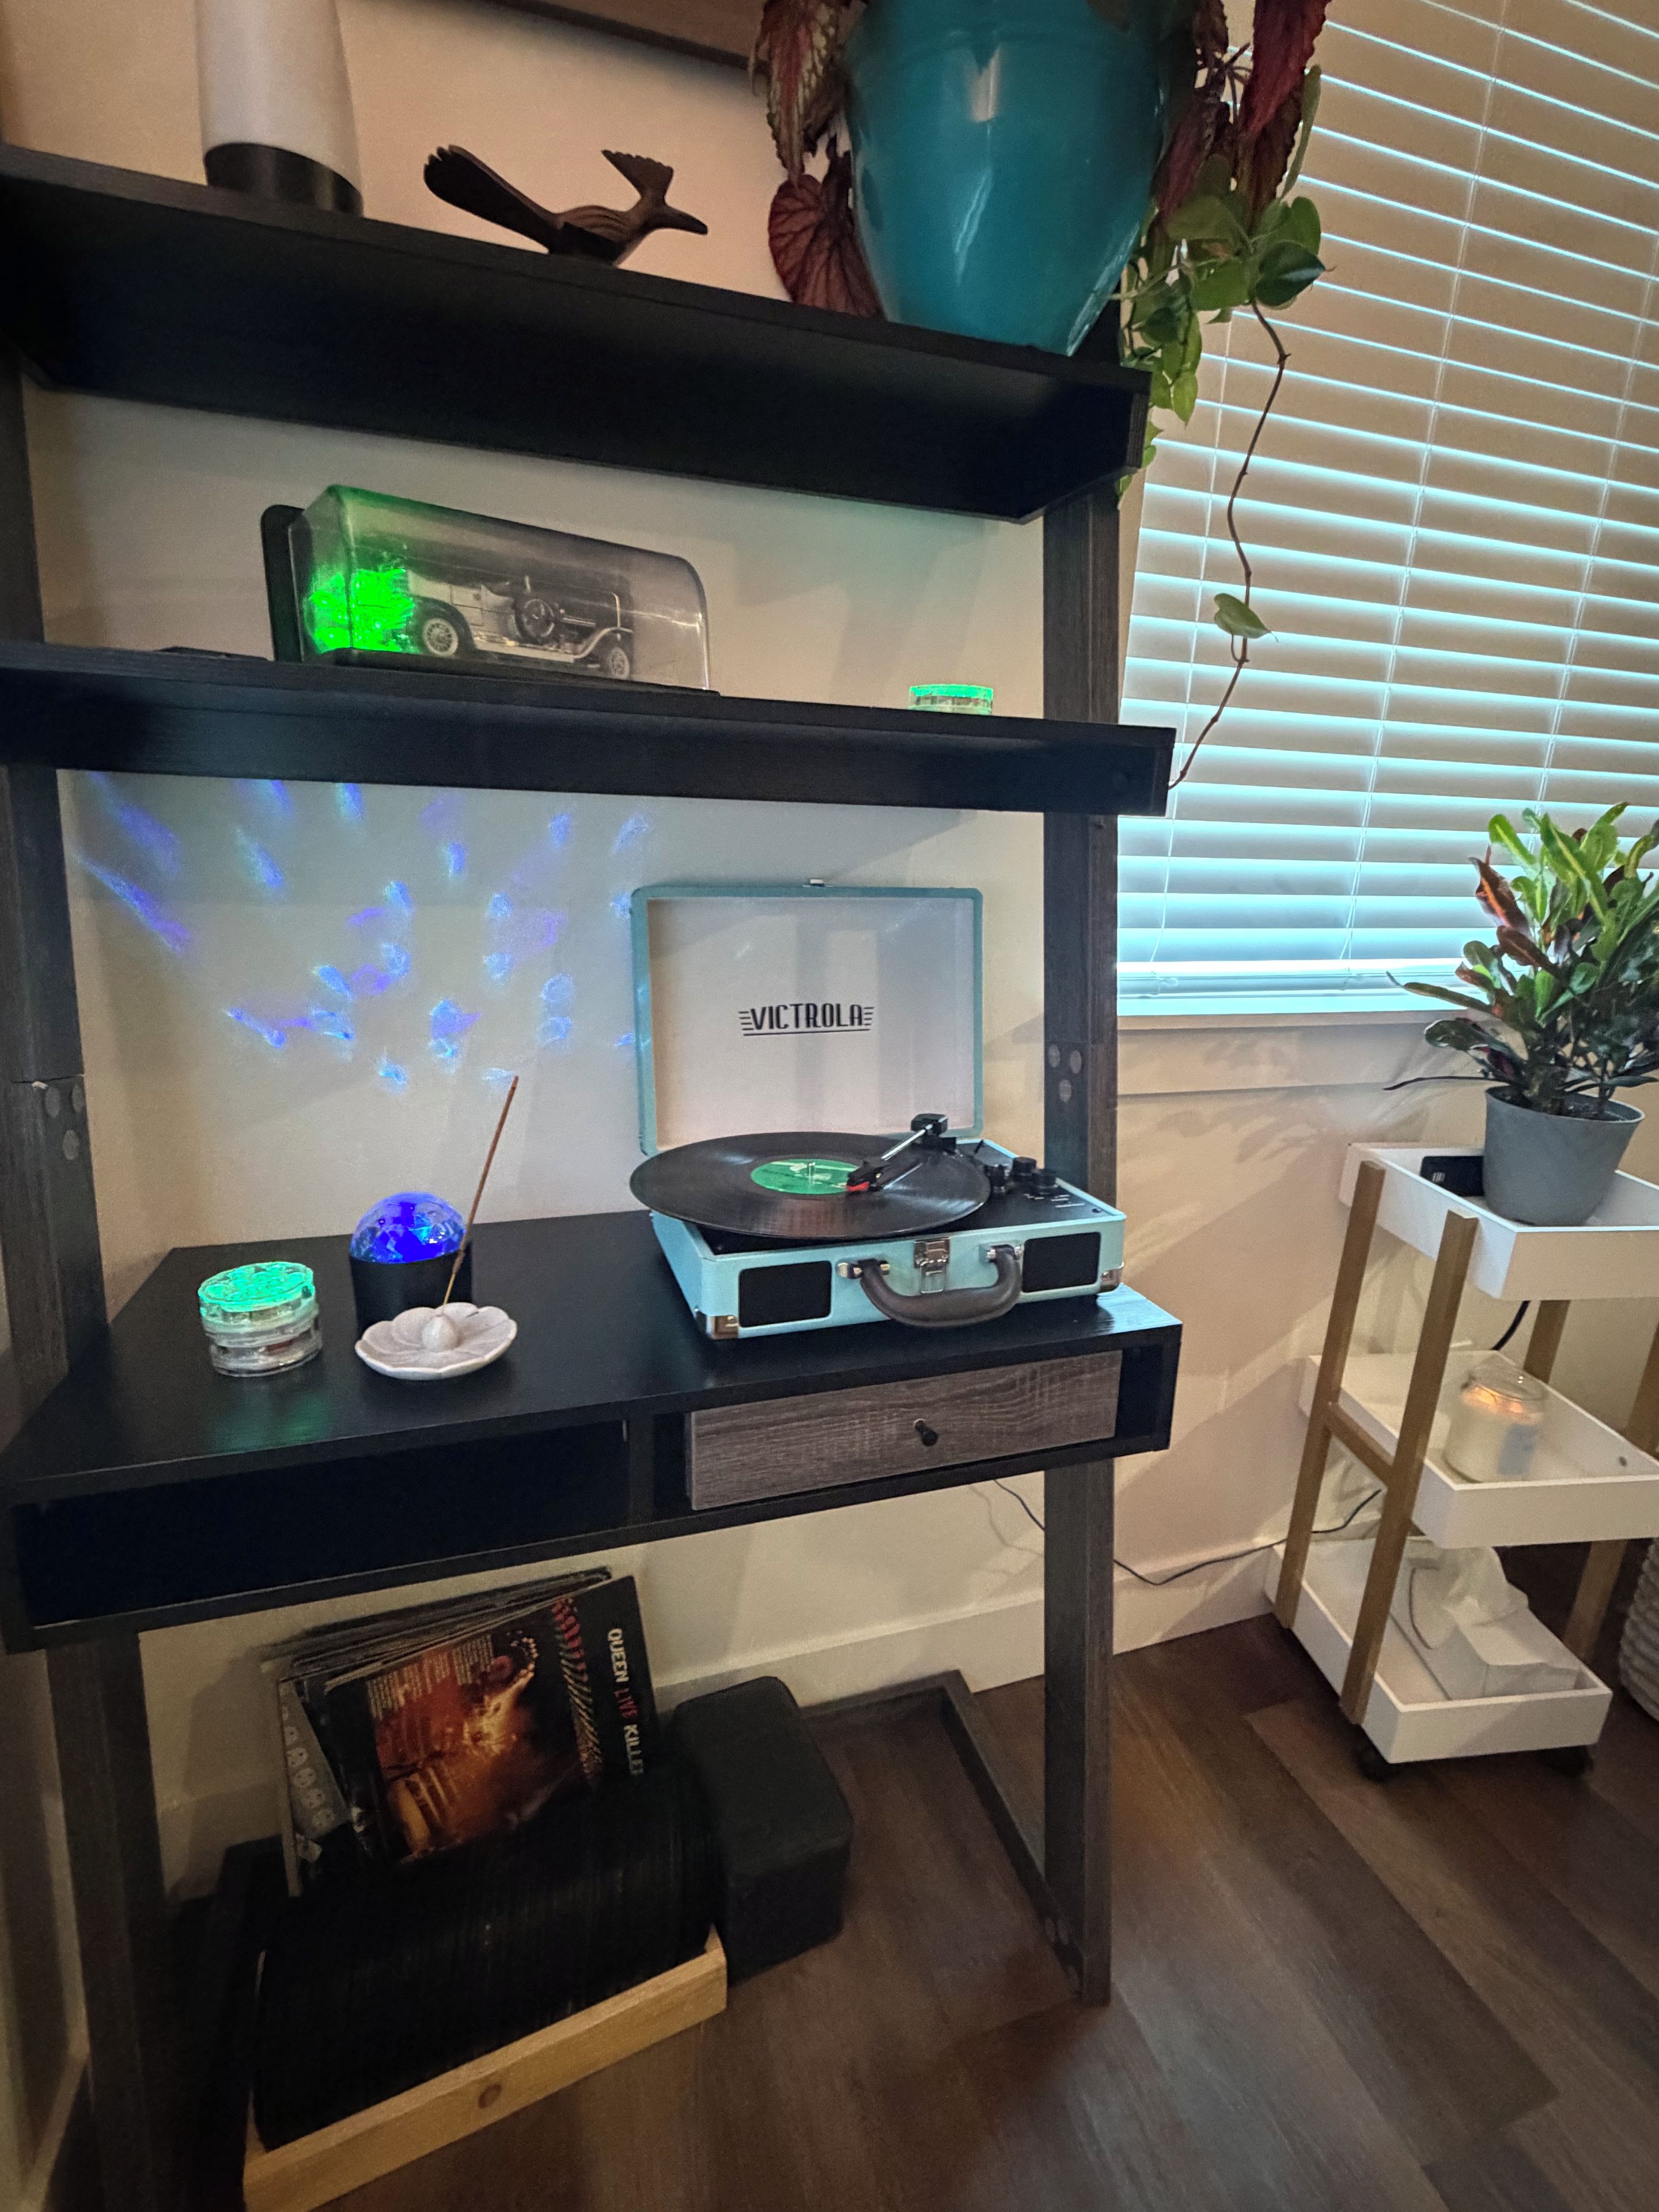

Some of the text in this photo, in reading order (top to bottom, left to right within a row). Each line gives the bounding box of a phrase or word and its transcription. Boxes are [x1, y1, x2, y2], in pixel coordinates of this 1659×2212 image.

[750, 1003, 863, 1030] VICTROLA
[608, 1627, 630, 1683] QUEEN
[613, 1688, 639, 1718] LIVE
